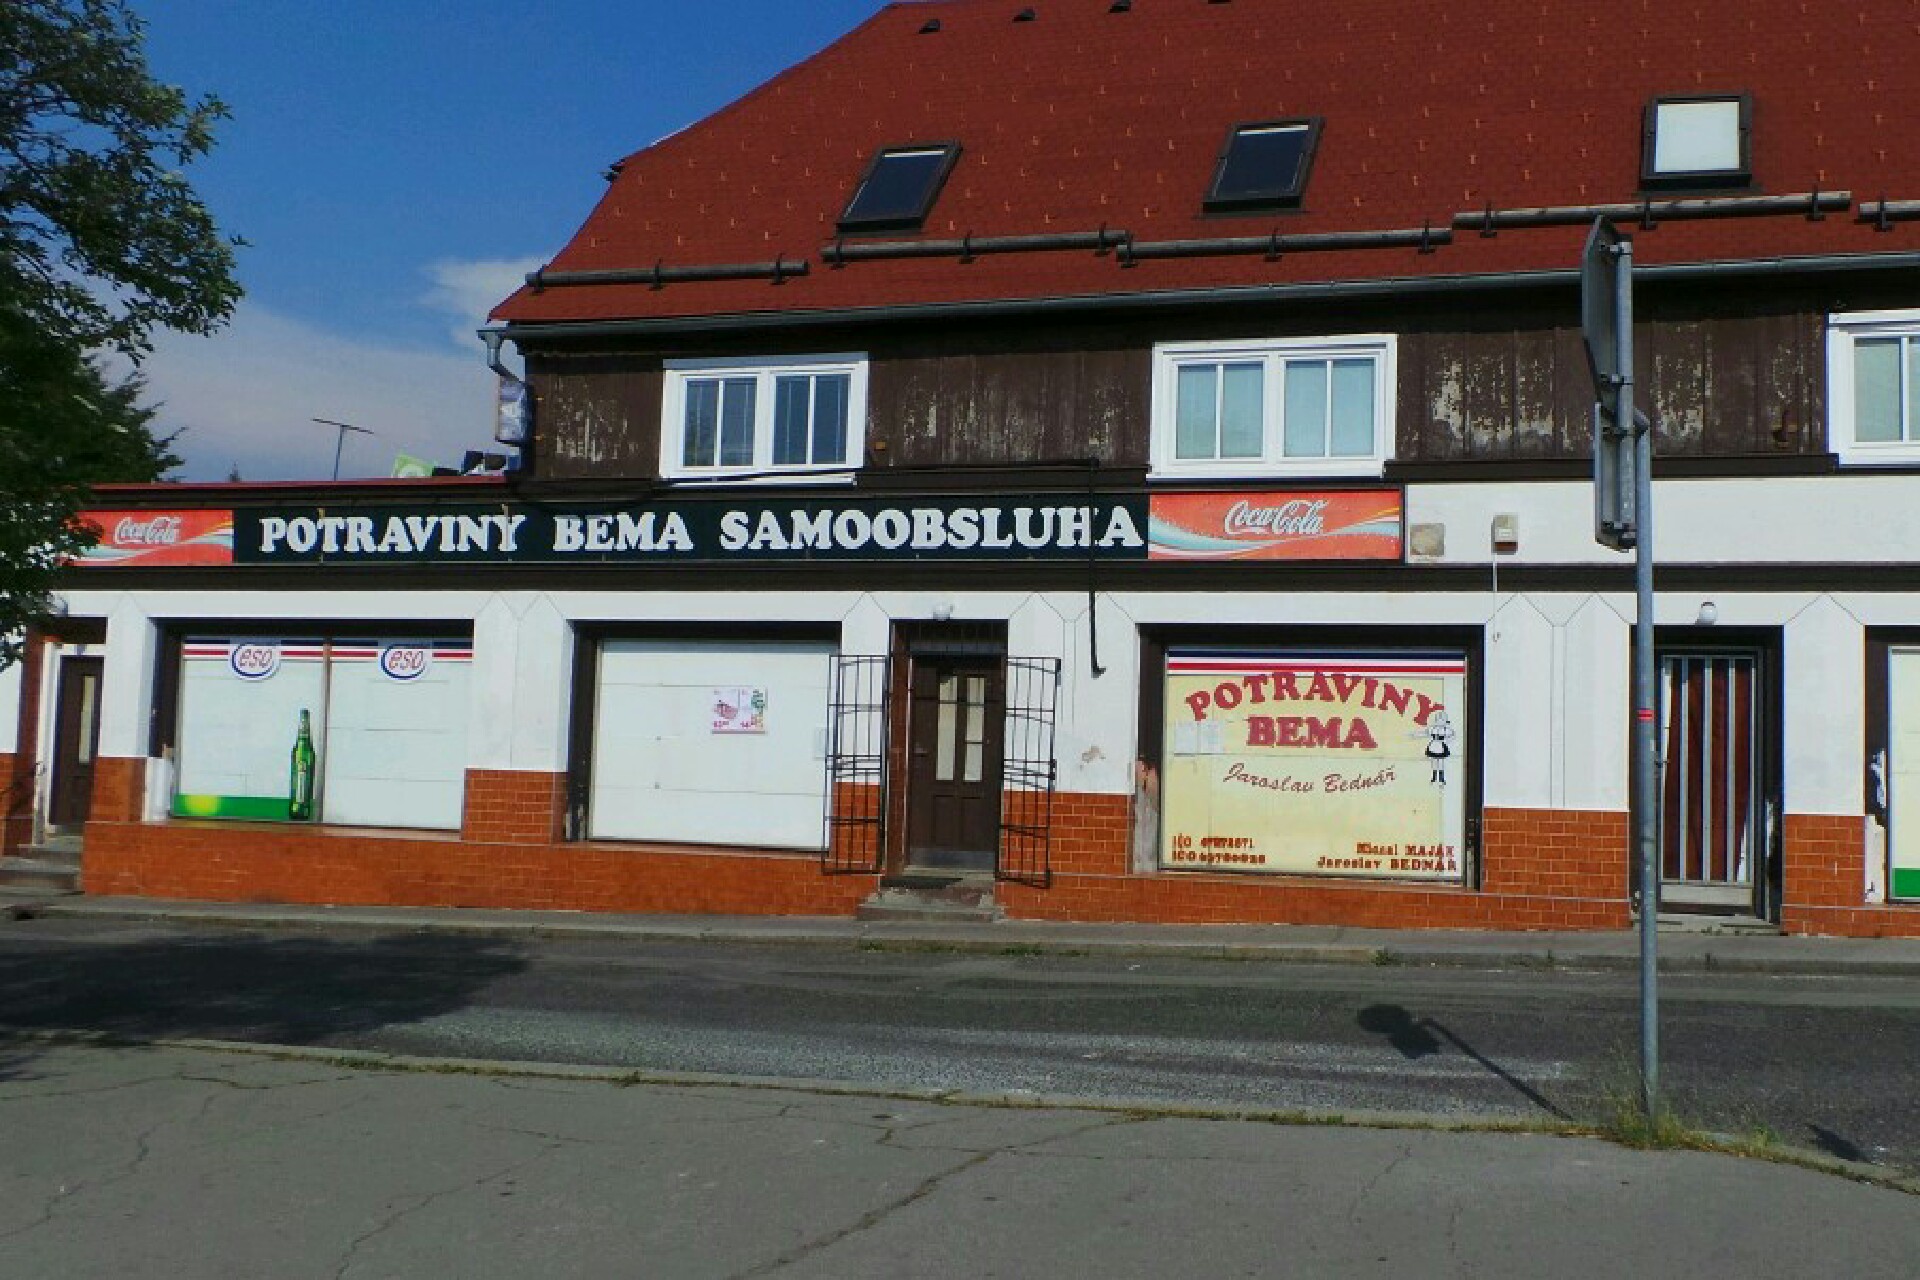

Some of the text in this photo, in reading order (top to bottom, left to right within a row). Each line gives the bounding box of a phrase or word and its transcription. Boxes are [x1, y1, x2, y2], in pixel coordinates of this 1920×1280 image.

[259, 505, 1144, 553] POTRAVINY BEMA SAMOOBSLUHA
[1185, 671, 1445, 727] POTRAVINY
[1245, 716, 1379, 749] BEMA
[1222, 762, 1314, 793] Jaroslav
